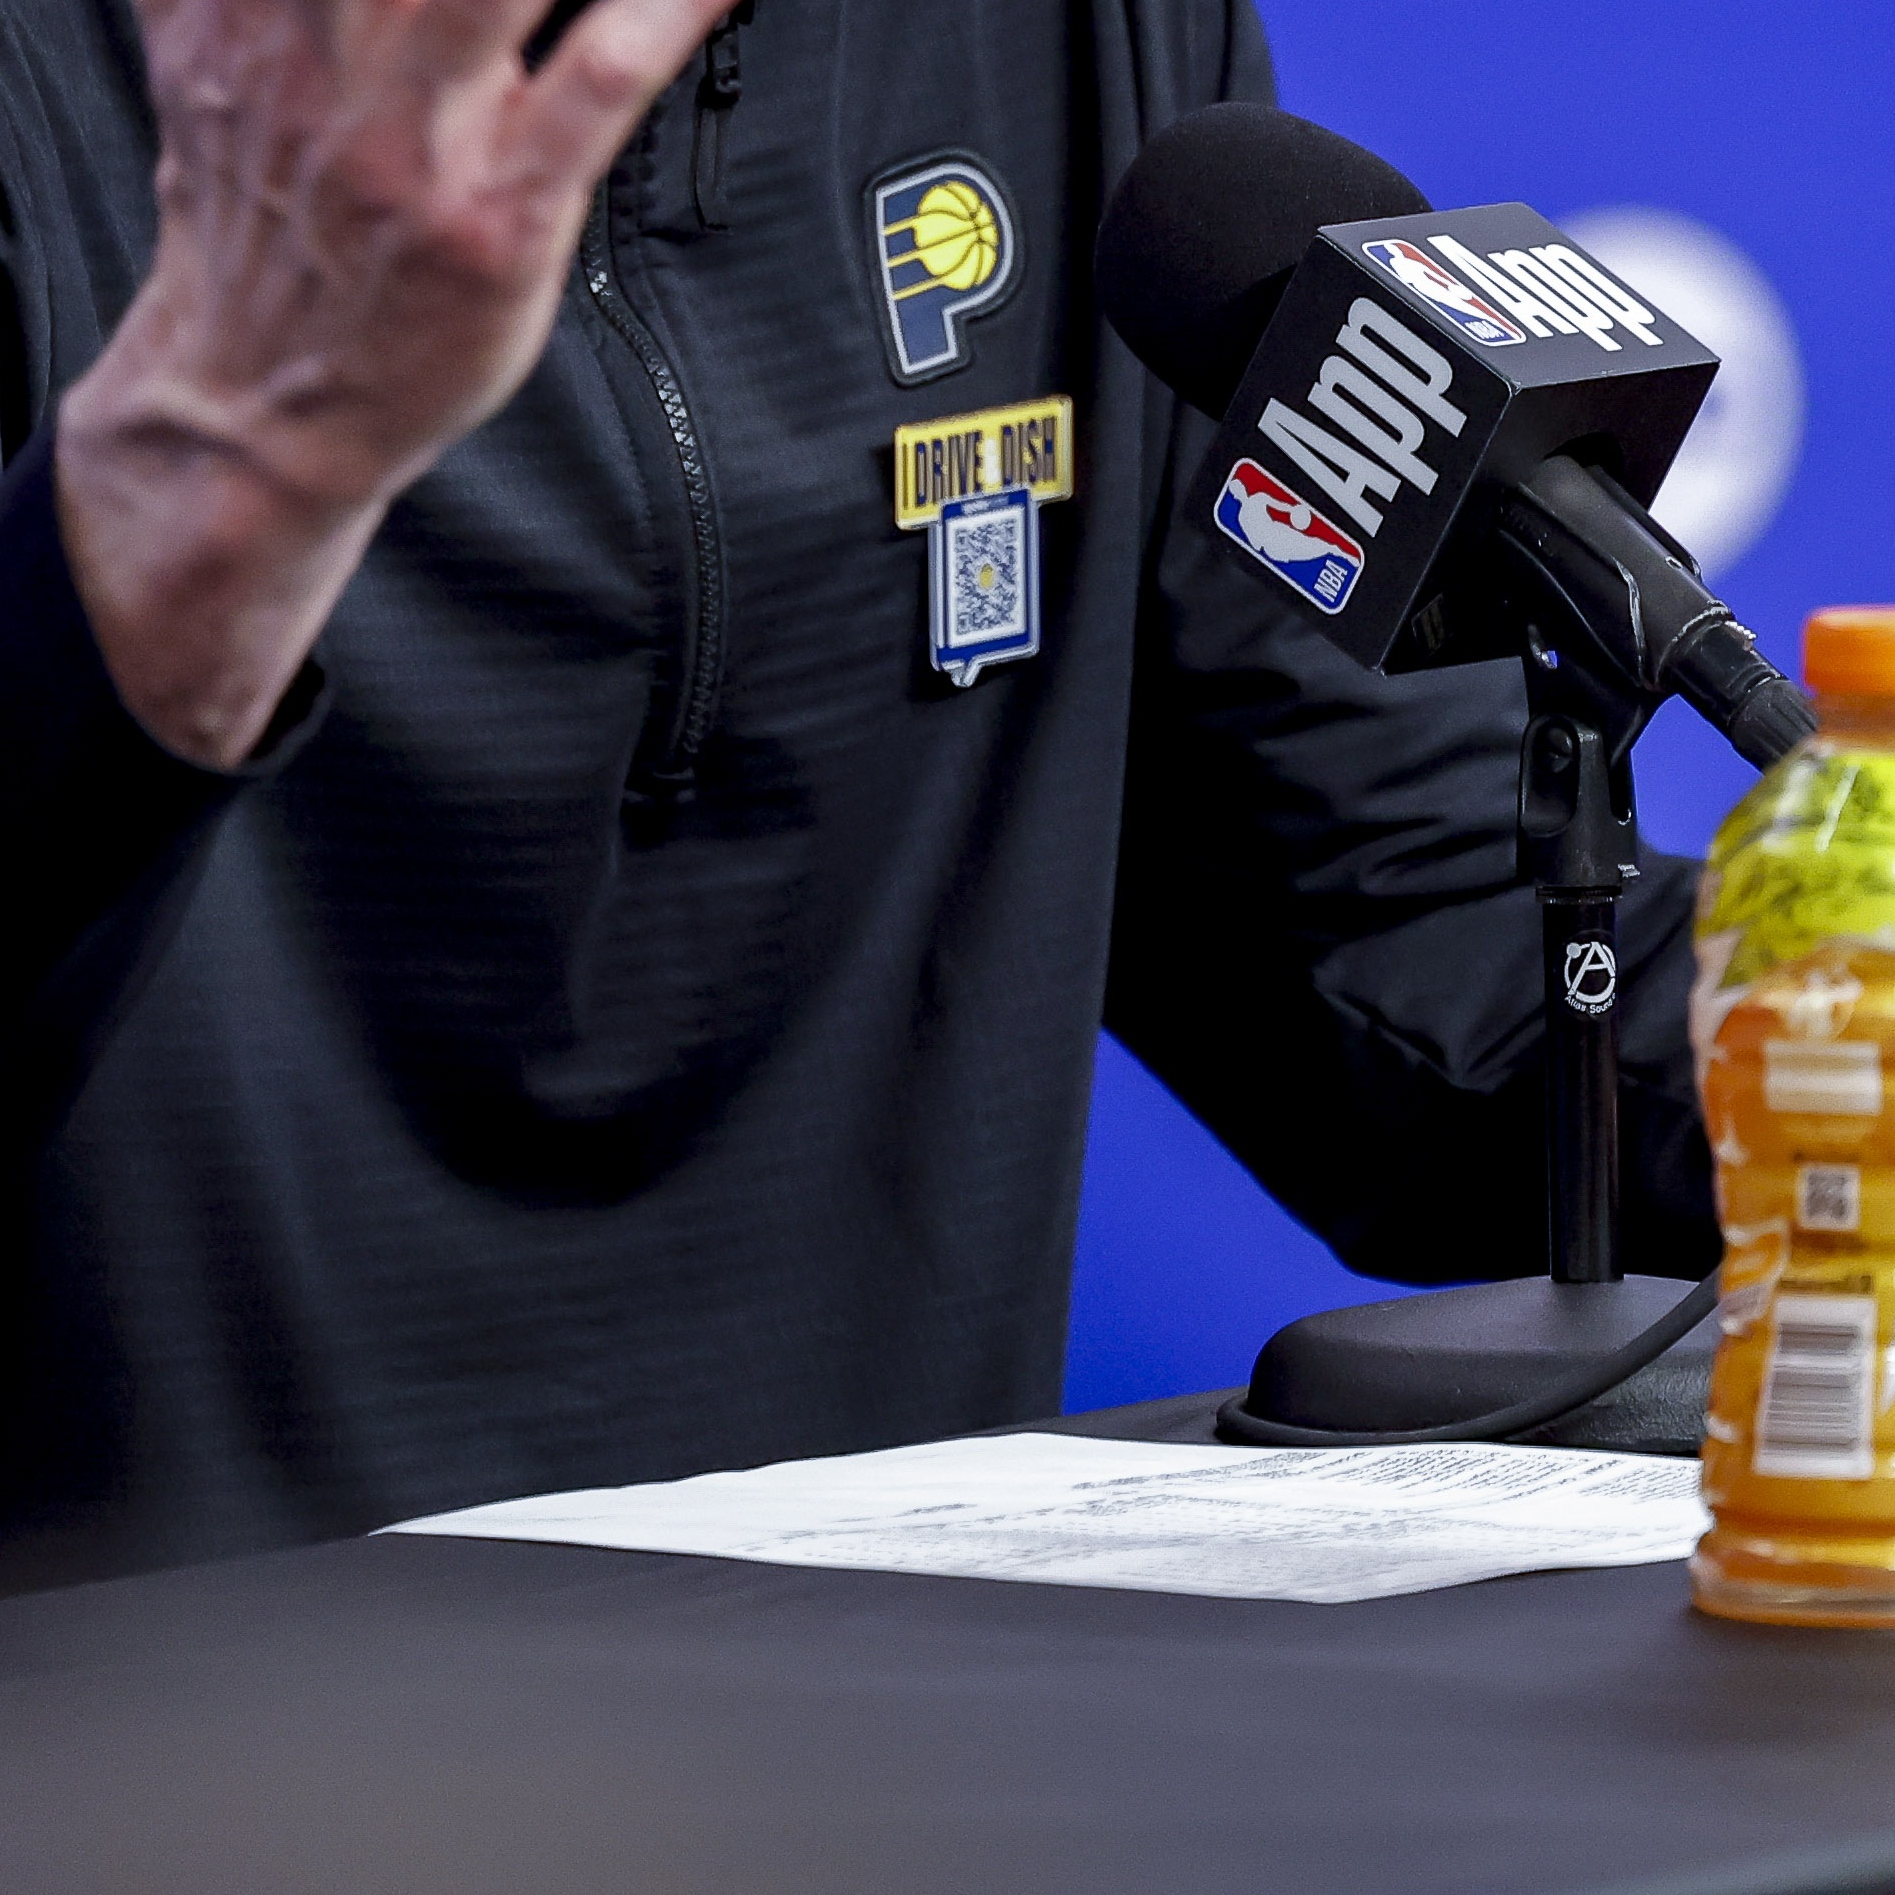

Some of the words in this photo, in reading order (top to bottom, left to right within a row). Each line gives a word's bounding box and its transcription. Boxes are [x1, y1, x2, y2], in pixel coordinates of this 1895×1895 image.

[1427, 234, 1663, 352] App
[915, 430, 982, 507] DRIVE
[1001, 416, 1056, 486] DISH
[1258, 296, 1468, 538] App
[1314, 559, 1348, 604] NBA
